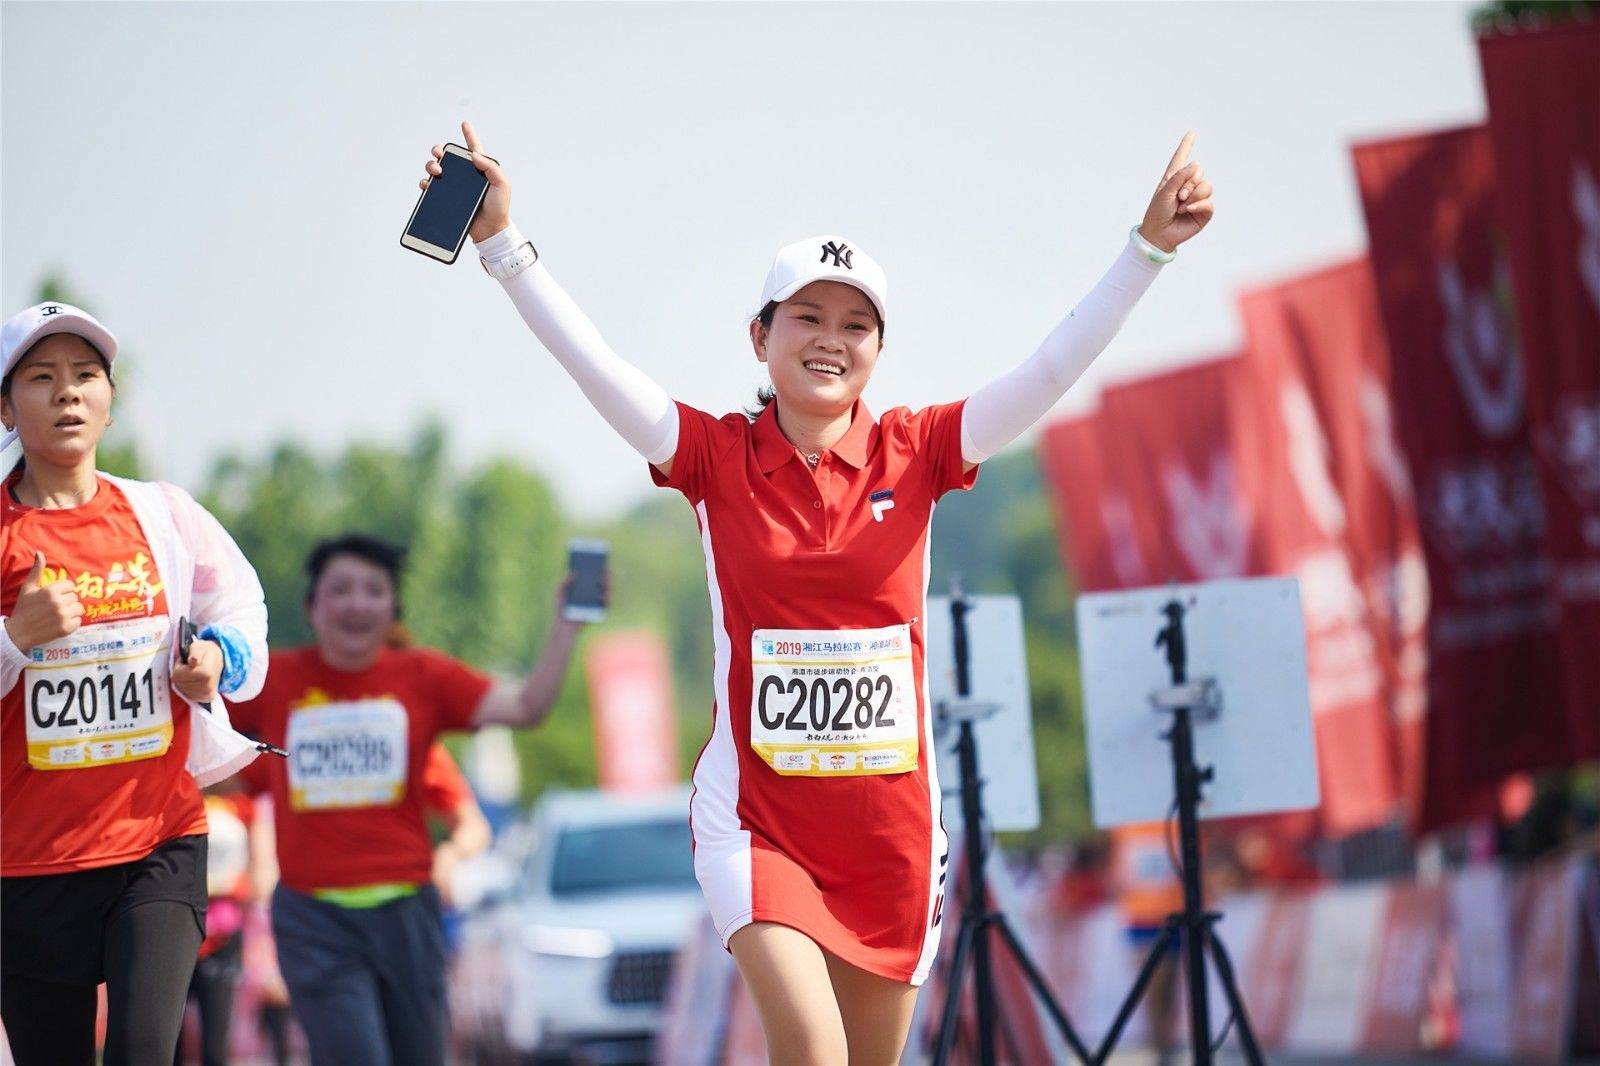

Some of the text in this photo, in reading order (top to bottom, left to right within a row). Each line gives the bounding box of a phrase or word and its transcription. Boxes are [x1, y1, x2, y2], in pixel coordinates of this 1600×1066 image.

[820, 240, 854, 270] NY
[46, 646, 71, 661] 2019
[776, 641, 802, 656] 2019
[31, 668, 155, 728] C20141
[758, 675, 895, 731] C20282
